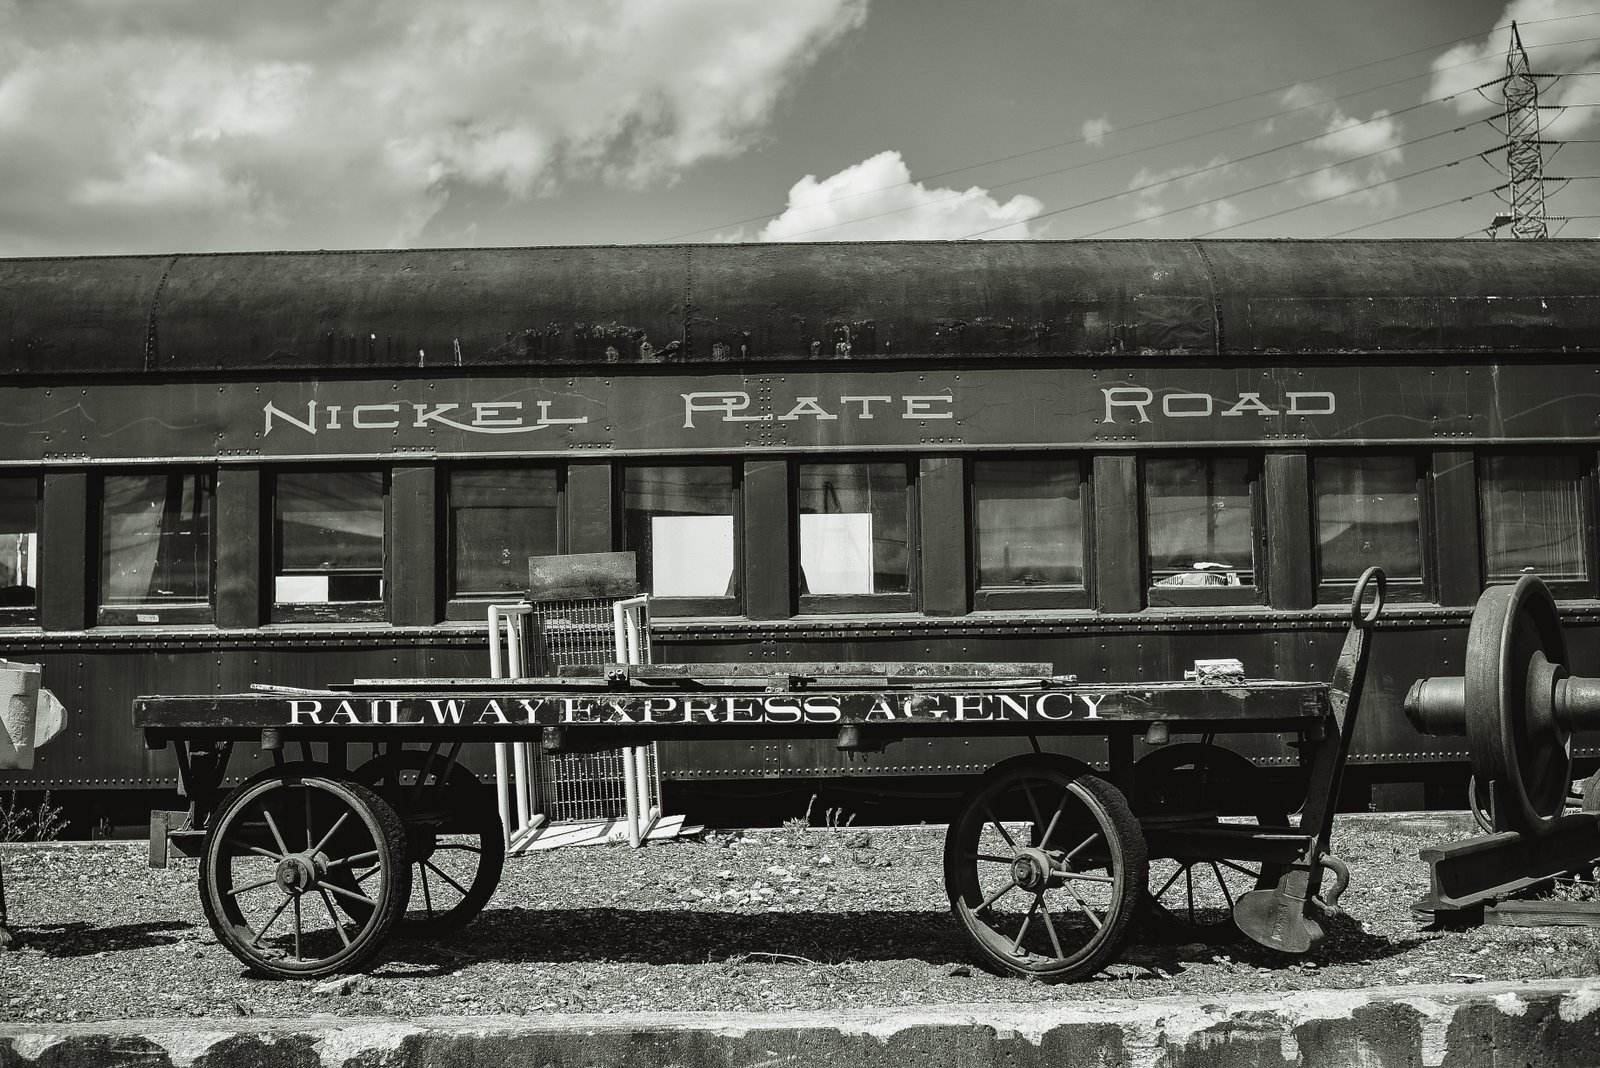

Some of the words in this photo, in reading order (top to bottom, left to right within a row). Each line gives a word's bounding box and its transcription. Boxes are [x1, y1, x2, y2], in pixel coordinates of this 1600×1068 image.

[263, 399, 588, 436] NICKEL
[680, 391, 954, 429] PLATE
[1101, 387, 1336, 424] ROAD
[286, 699, 544, 725] RAILWAY
[559, 696, 841, 723] EXPRESS
[865, 693, 1106, 721] AGENCY
